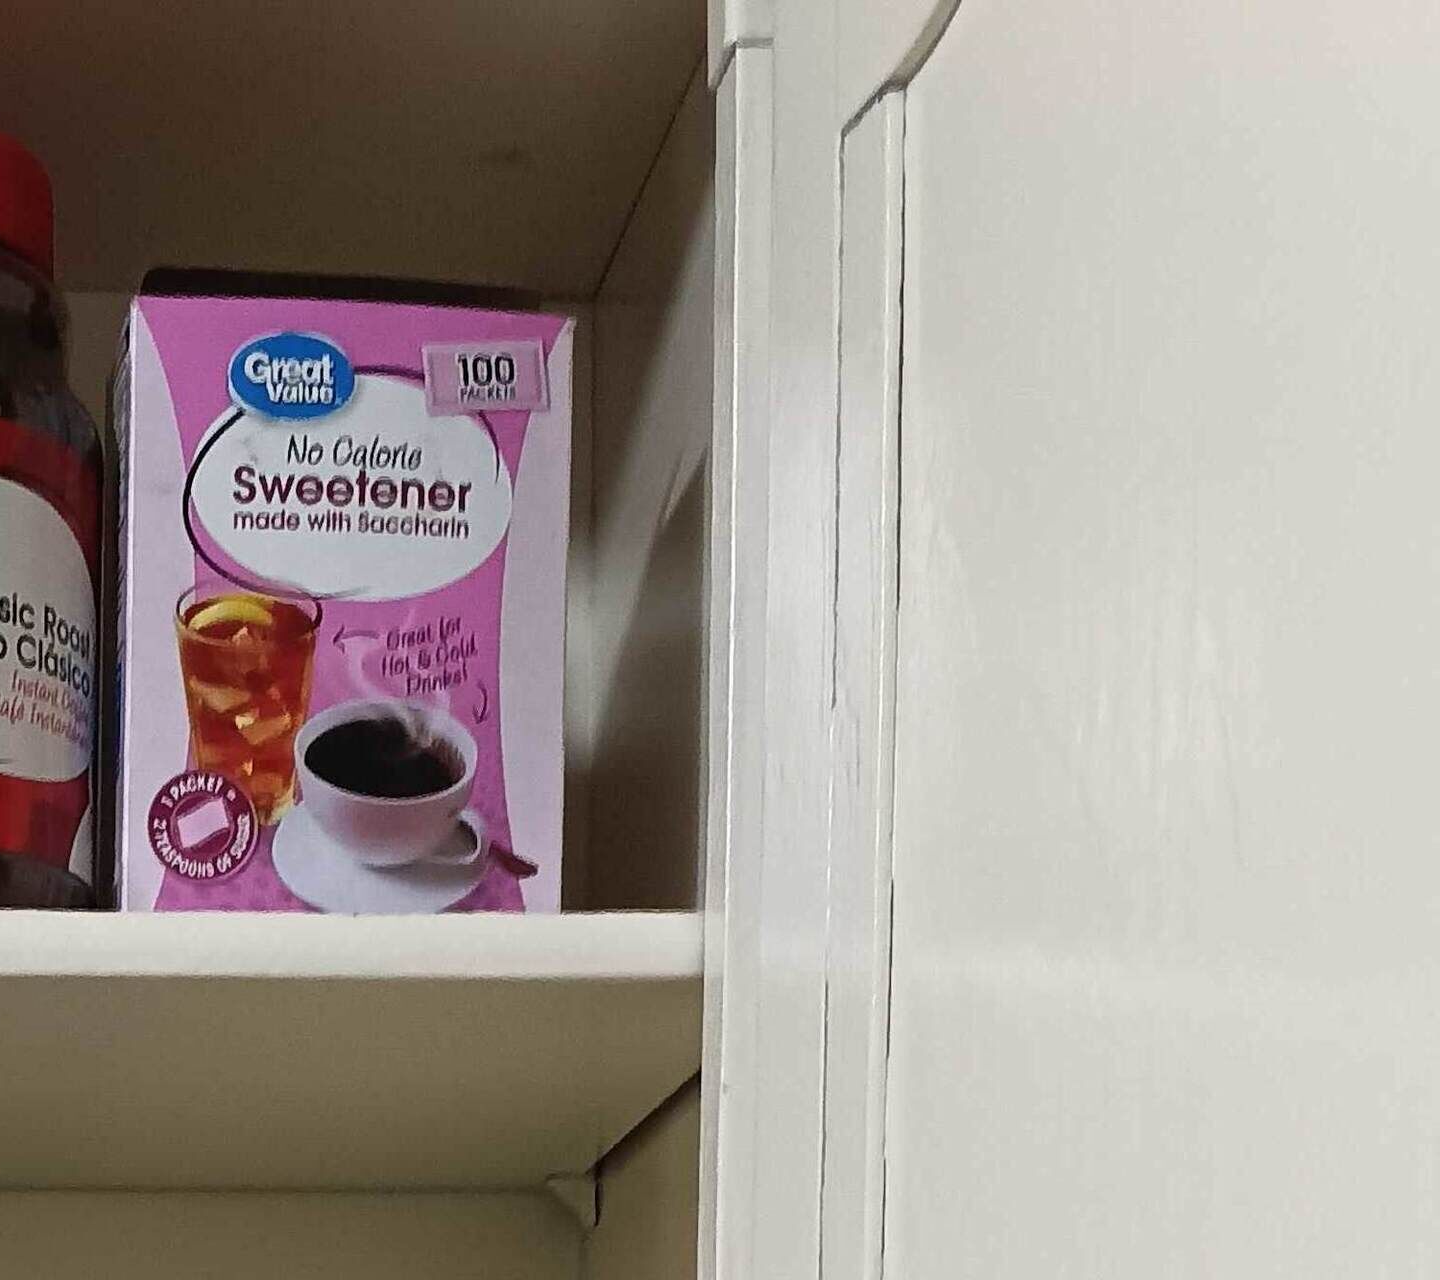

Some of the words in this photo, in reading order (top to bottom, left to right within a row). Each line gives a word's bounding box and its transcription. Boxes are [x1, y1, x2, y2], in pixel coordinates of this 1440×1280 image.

[244, 351, 335, 386] Great
[457, 352, 516, 386] 100
[265, 381, 334, 404] Value
[287, 434, 323, 466] No
[332, 434, 423, 471] Calorie
[232, 463, 473, 514] Sweetener
[232, 509, 301, 532] made
[307, 509, 352, 533] with
[357, 511, 471, 540] Saccharin
